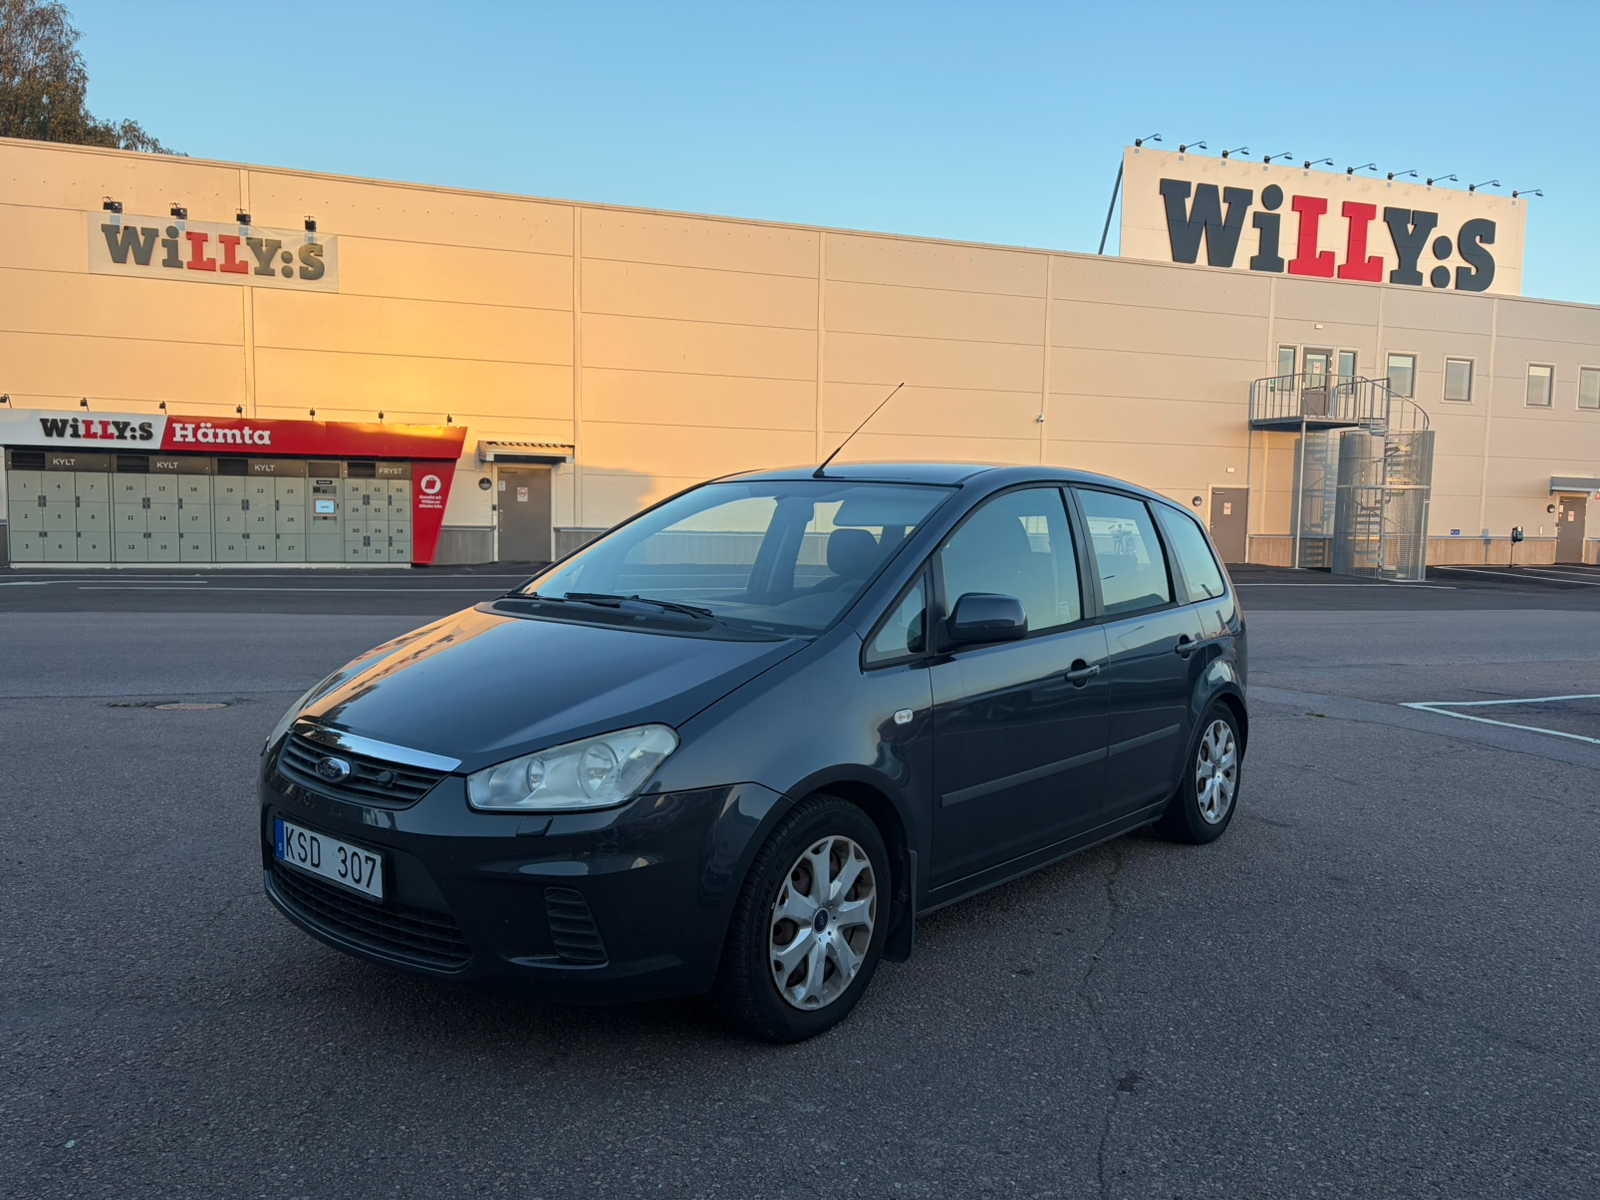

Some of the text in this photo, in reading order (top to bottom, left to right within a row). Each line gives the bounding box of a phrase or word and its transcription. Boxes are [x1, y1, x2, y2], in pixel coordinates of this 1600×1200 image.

[1159, 177, 1496, 293] WiLLY:S
[100, 223, 326, 281] WiLLY:S
[39, 417, 154, 441] WiLLY:S
[172, 422, 271, 445] Hämta
[52, 458, 76, 466] KYLT
[156, 461, 179, 469] KYLT
[254, 464, 275, 472] KYLT
[378, 467, 403, 475] FRYST
[285, 825, 377, 888] KSD 307
[754, 877, 776, 962] GENERAL
